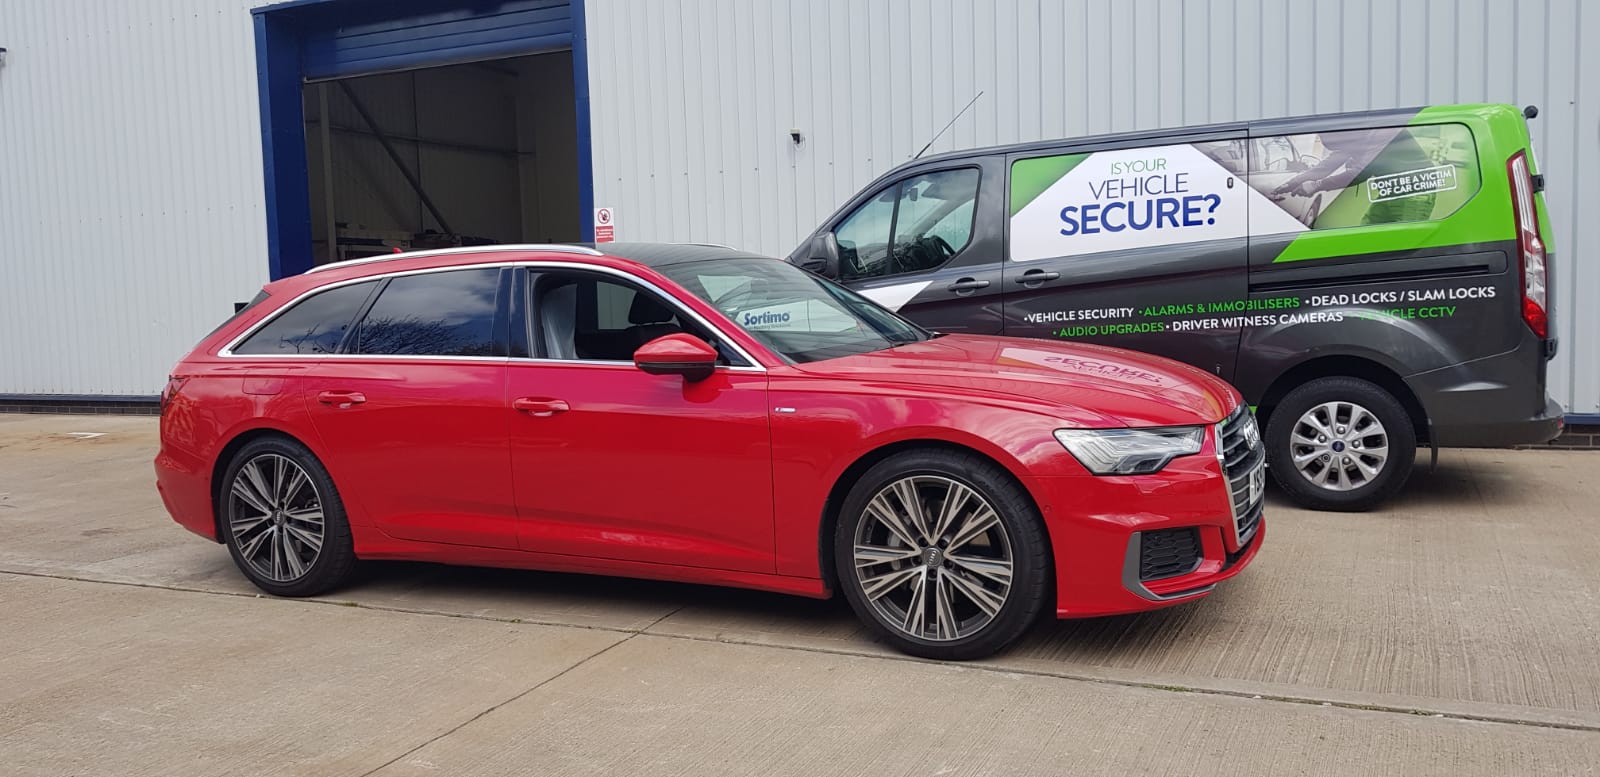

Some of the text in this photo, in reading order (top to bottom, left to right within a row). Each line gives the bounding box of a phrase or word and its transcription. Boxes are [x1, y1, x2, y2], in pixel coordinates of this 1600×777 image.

[1111, 158, 1167, 175] IS YOUR
[1400, 176, 1411, 186] BE
[1412, 174, 1420, 183] A
[1420, 169, 1452, 180] VICTIM
[1088, 172, 1189, 200] VEHICLE
[1379, 179, 1446, 196] OF CAR CRIME!
[1060, 193, 1222, 236] SECURE?
[1028, 310, 1076, 323] VEHICLE
[1078, 307, 1134, 320] SECURITY
[1143, 304, 1194, 317] ALARMS
[1197, 303, 1205, 313] &
[1208, 297, 1300, 313] IMMOBILISERS
[1311, 295, 1349, 307] DEAD
[1352, 291, 1397, 305] LOCKS
[1408, 288, 1446, 301] SLAM
[1449, 286, 1496, 299] LOCKS
[744, 311, 791, 326] Sortimo
[1059, 325, 1098, 337] AUDIO
[1101, 321, 1164, 335] UPGRADES
[1172, 318, 1219, 331] DRIVER
[1221, 314, 1277, 328] WITNESS
[1279, 311, 1344, 324] CAMERAS
[1418, 306, 1456, 318] CCTV
